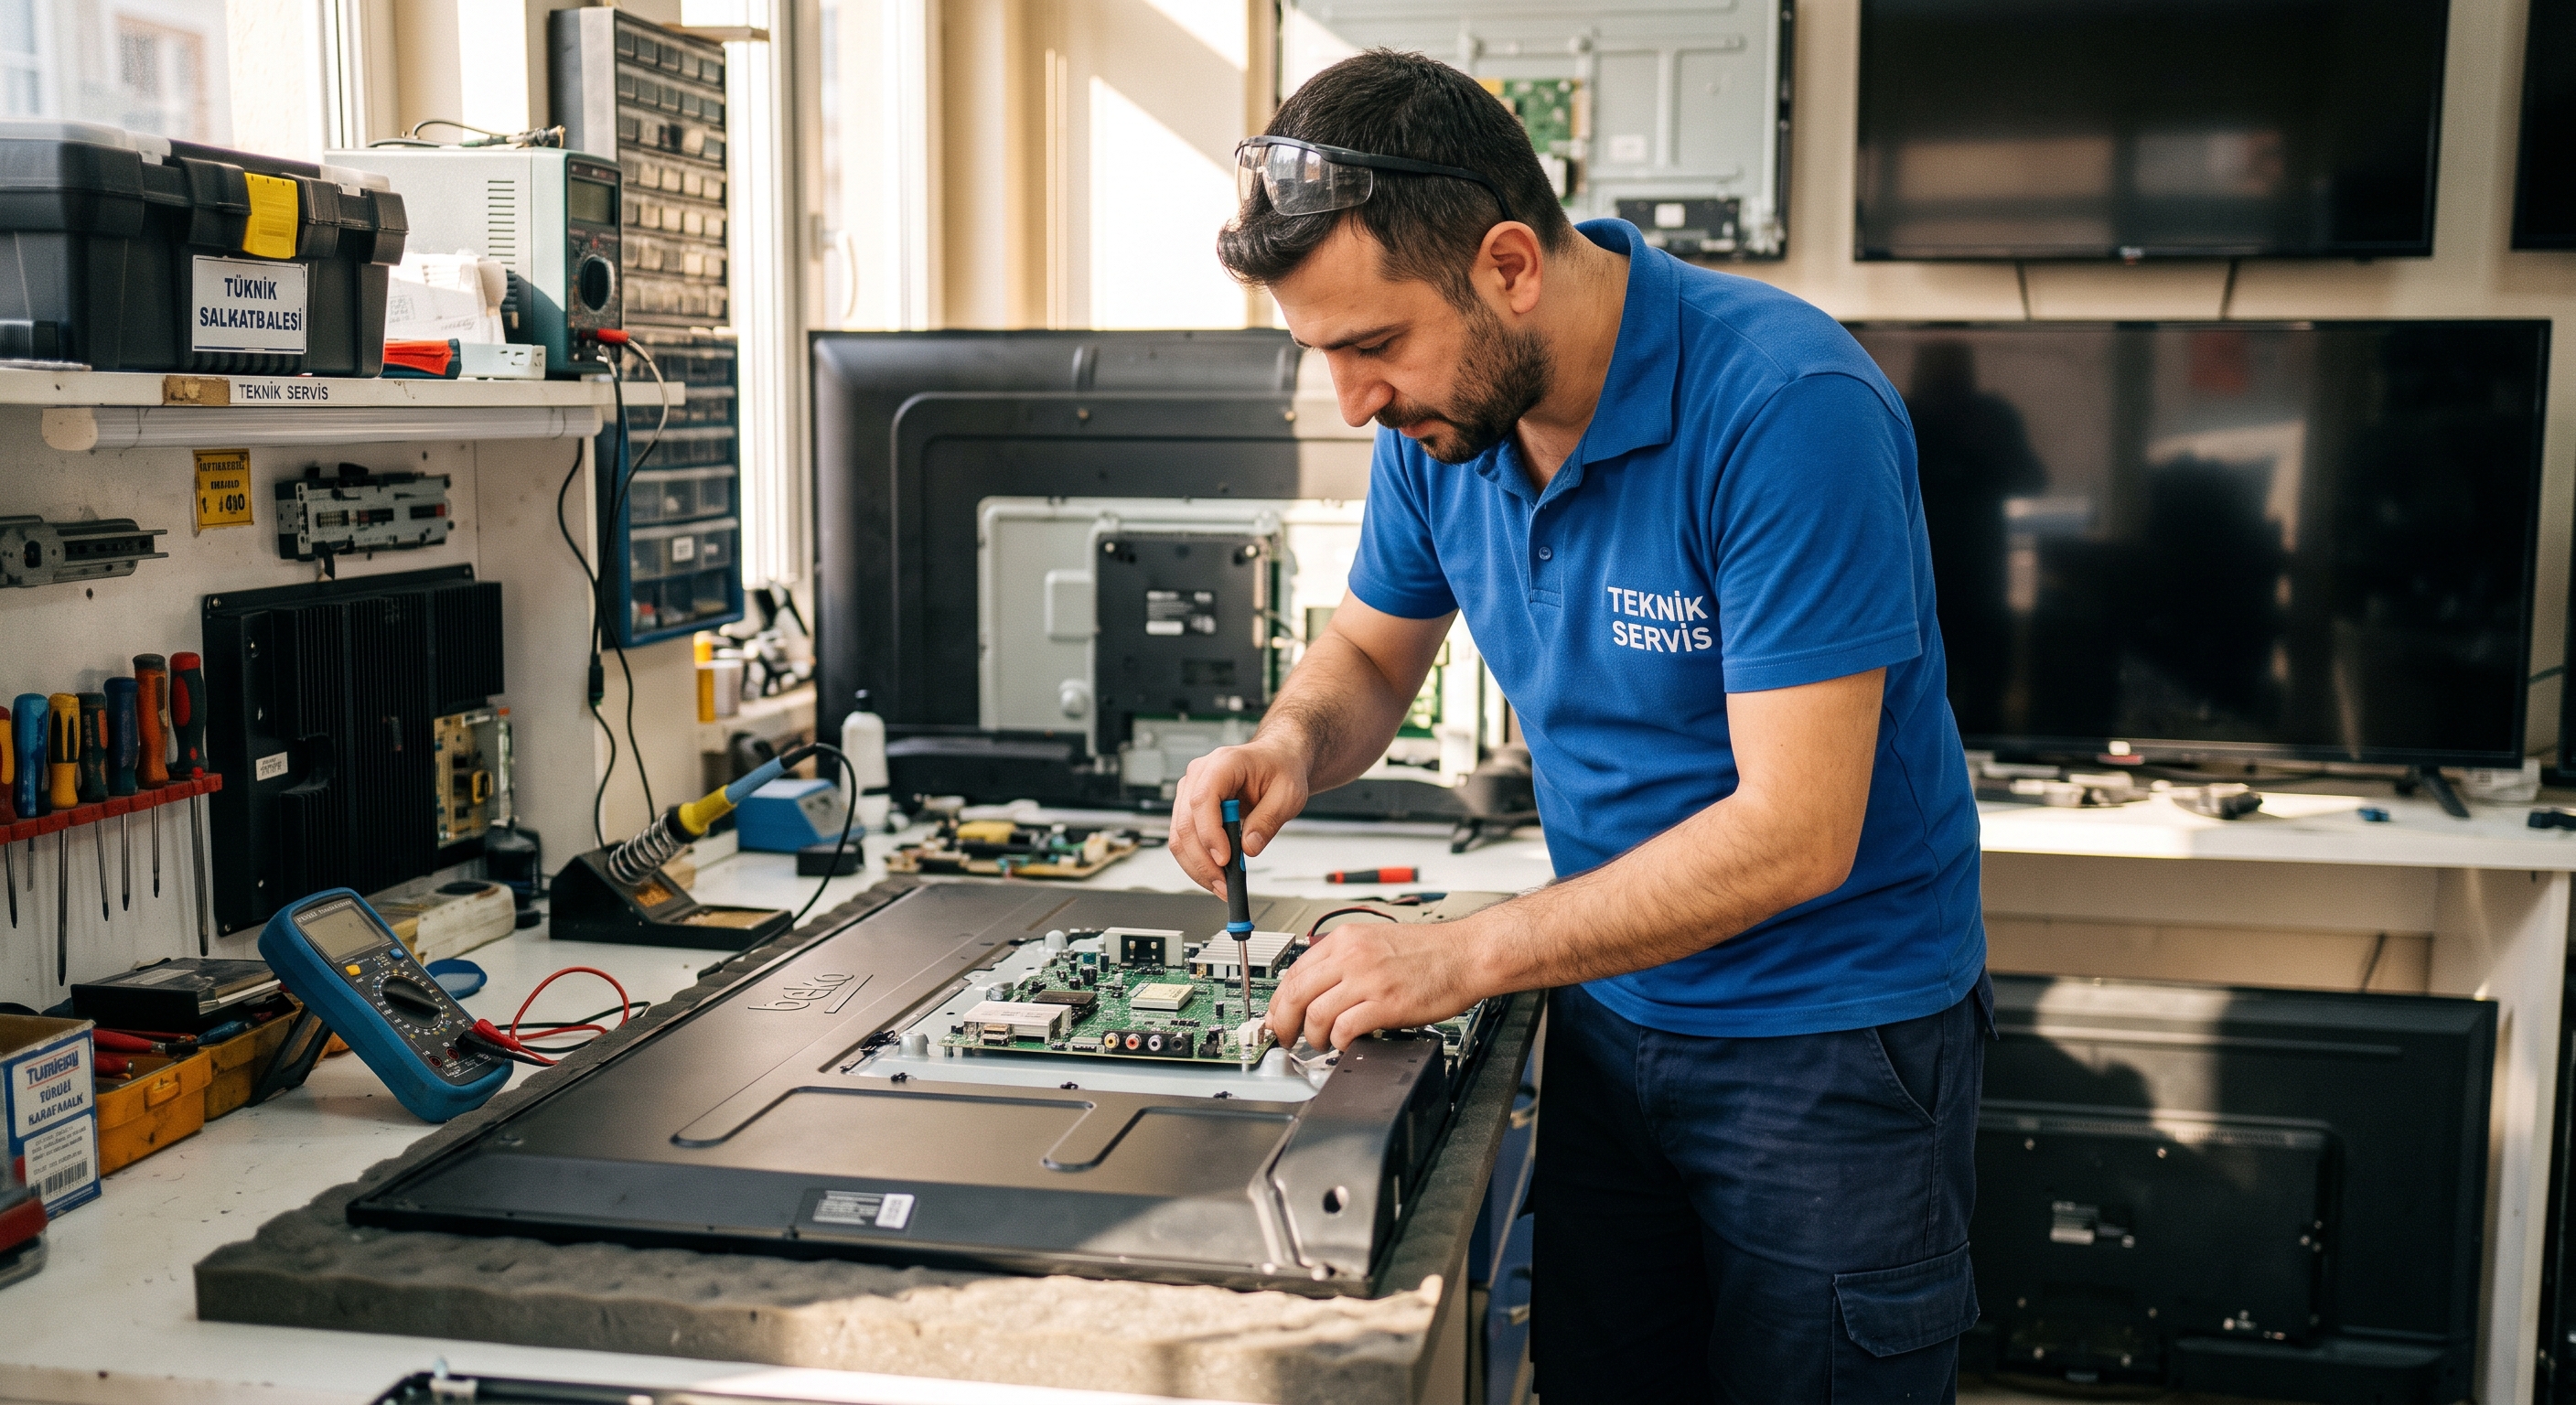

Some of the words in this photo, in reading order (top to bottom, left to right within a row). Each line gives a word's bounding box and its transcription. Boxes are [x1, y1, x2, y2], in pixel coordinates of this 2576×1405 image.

[224, 273, 277, 301] TÜKNİK
[199, 306, 302, 331] SALKATBALESİ
[238, 381, 282, 400] TEKNİK
[287, 382, 328, 401] SERVİS
[1607, 586, 1709, 622] TEKNİK
[1612, 620, 1712, 653] SERVİS
